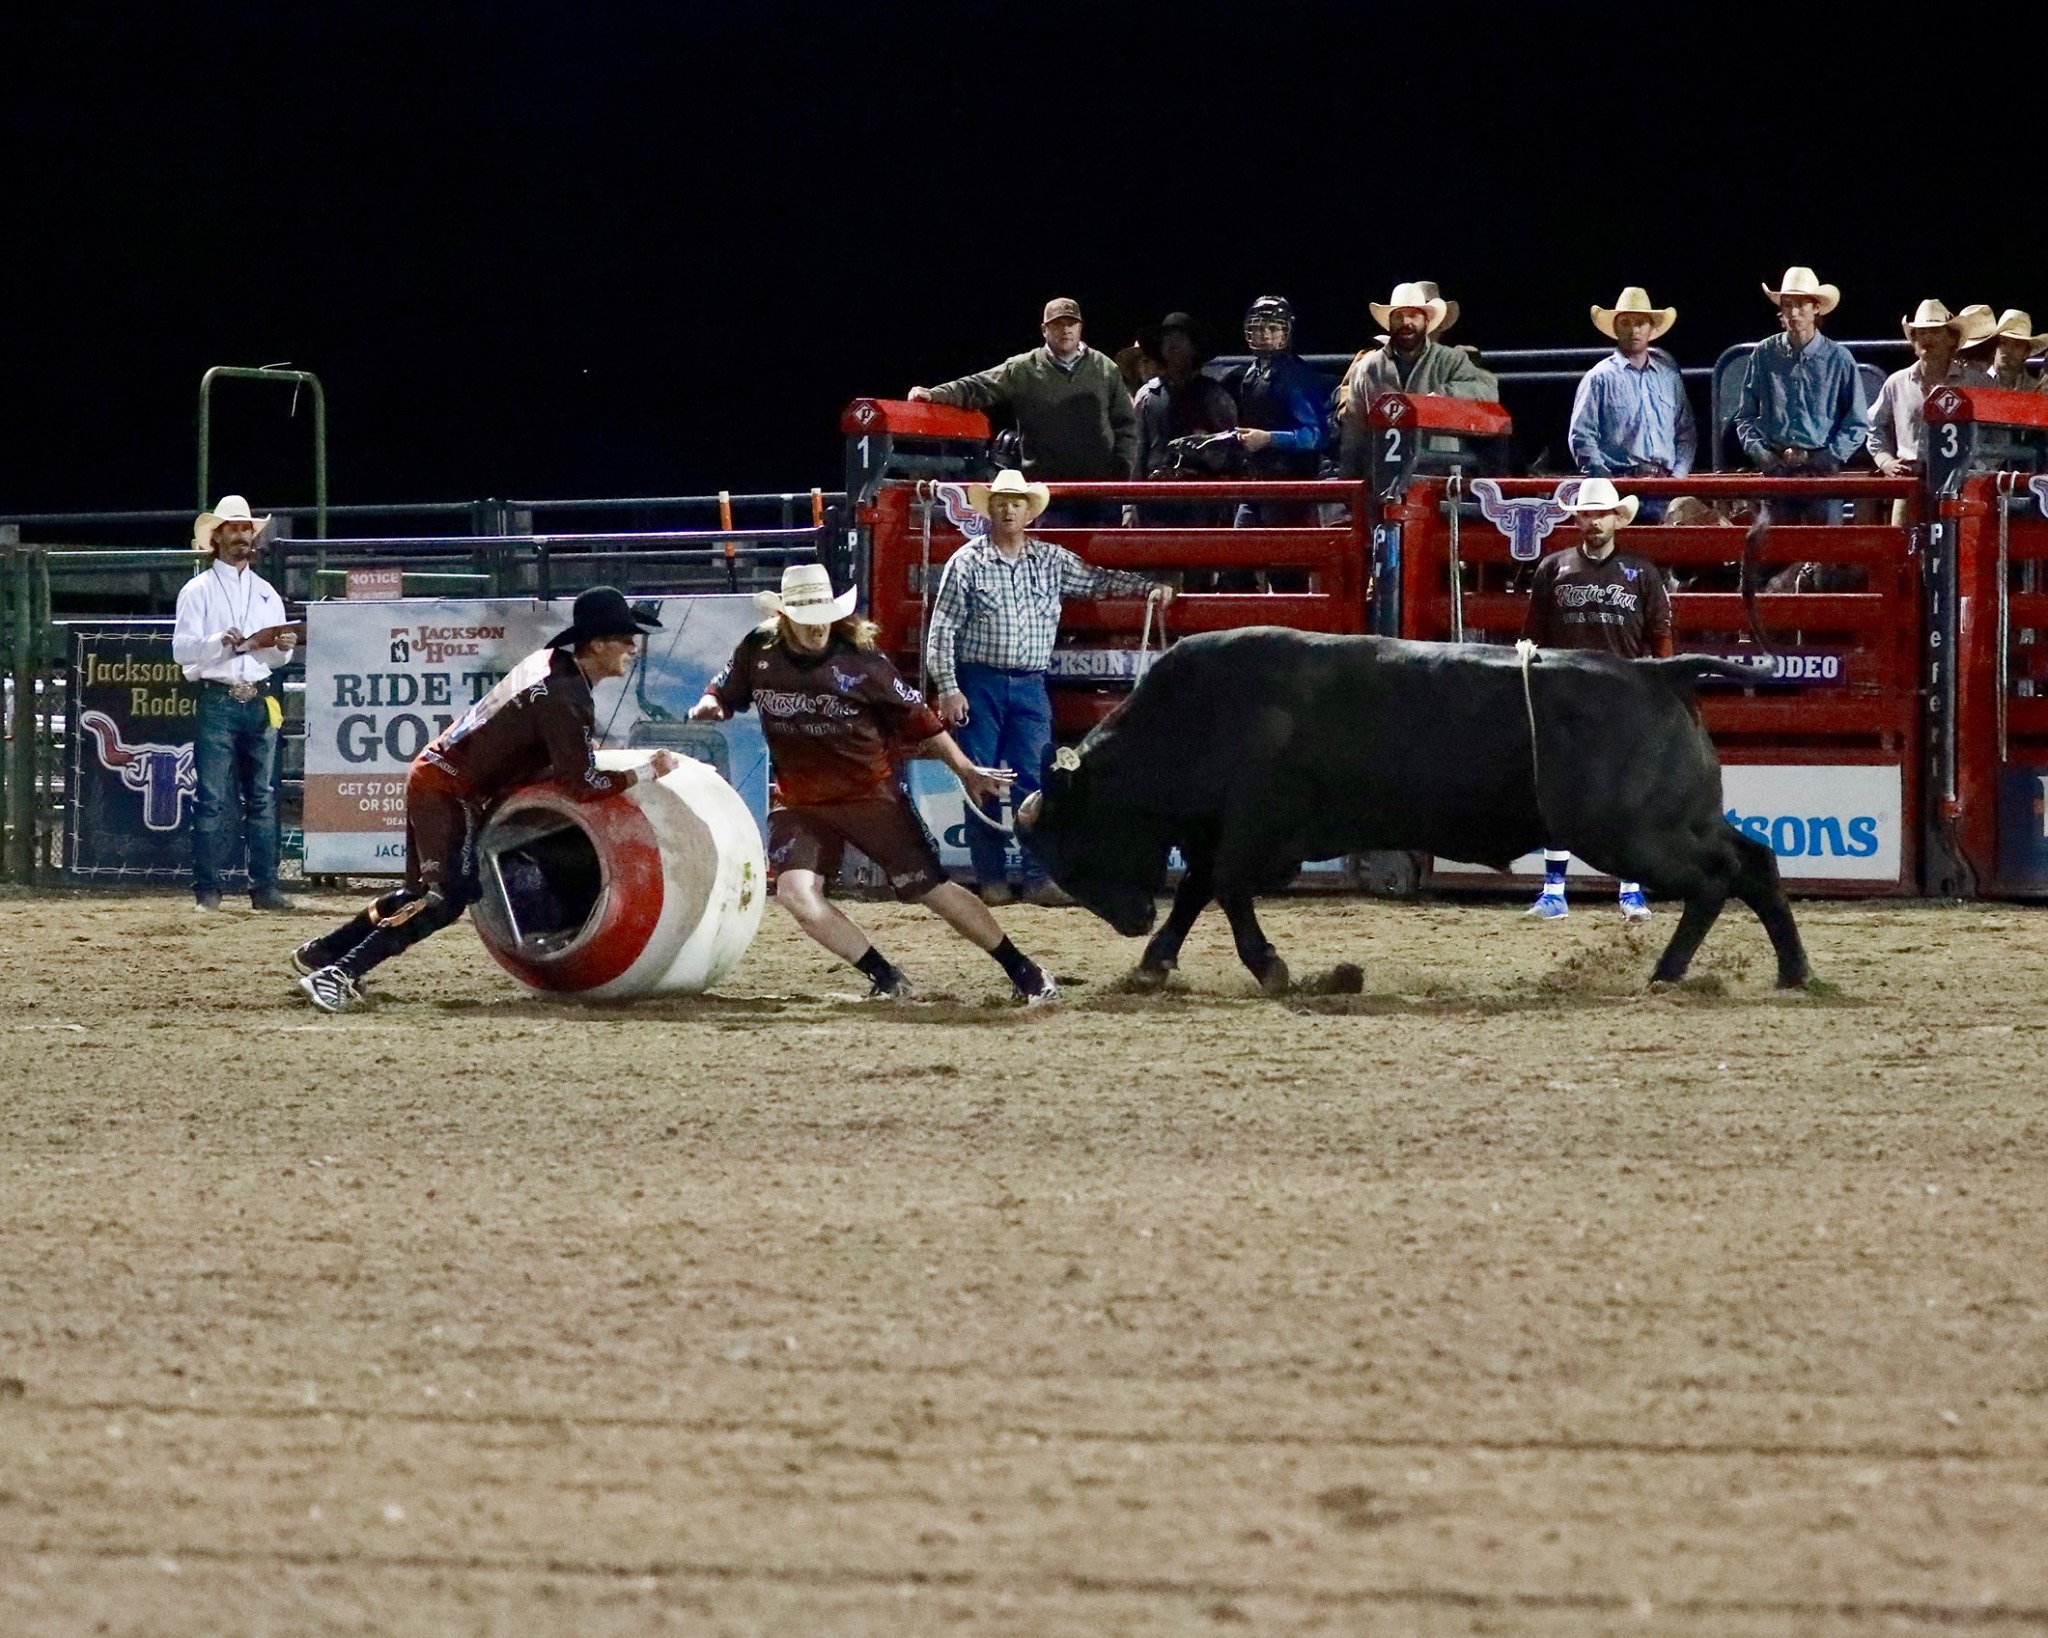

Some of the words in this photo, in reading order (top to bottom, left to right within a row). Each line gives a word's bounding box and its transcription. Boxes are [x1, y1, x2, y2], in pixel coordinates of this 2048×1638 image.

[857, 435, 869, 469] 1
[1384, 428, 1401, 462] 2
[1940, 423, 1958, 458] 3
[350, 572, 399, 585] NOTICE
[1554, 583, 1606, 607] Rustic
[411, 625, 505, 652] JACKSON
[425, 642, 479, 663] HOLE
[1046, 651, 1125, 675] CKSON
[86, 653, 181, 687] Jackson
[130, 687, 197, 716] Rode
[332, 672, 451, 707] RIDE
[337, 782, 364, 795] GET
[366, 781, 382, 796] $7
[359, 799, 380, 812] OR
